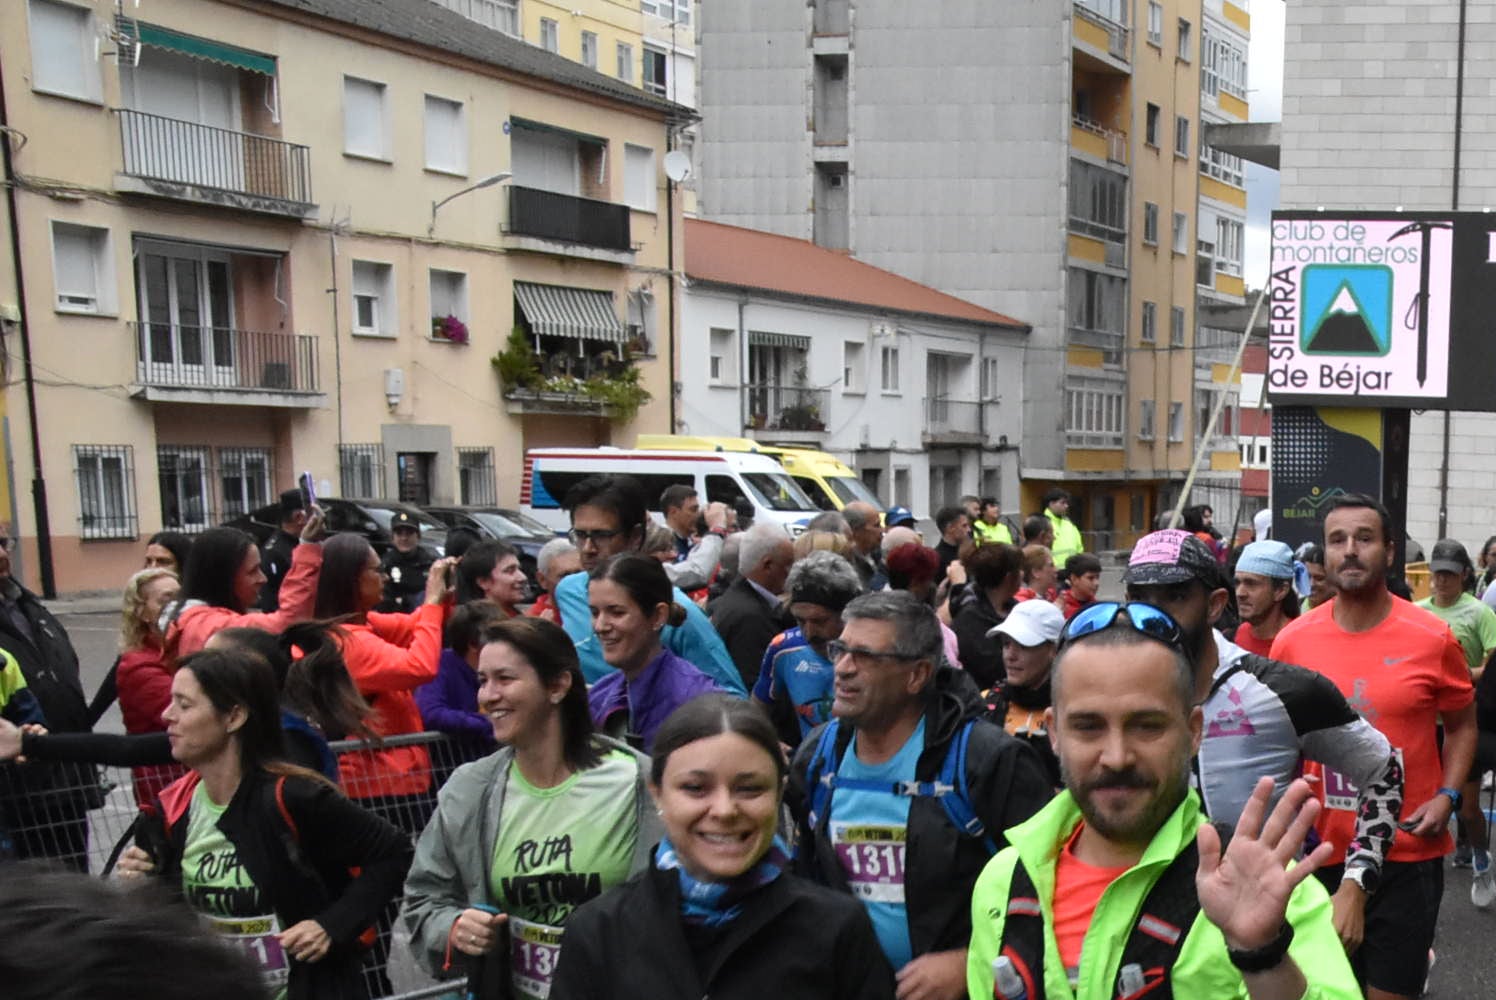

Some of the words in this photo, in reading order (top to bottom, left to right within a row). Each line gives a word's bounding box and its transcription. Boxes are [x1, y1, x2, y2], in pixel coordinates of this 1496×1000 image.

[1273, 221, 1325, 241] club
[1333, 221, 1366, 241] de
[1272, 242, 1419, 264] montañeros
[1270, 265, 1297, 360] SIERRA
[1270, 364, 1308, 388] de
[1320, 363, 1392, 396] Béjar
[194, 851, 243, 886] RUTA
[514, 833, 574, 873] RUTA
